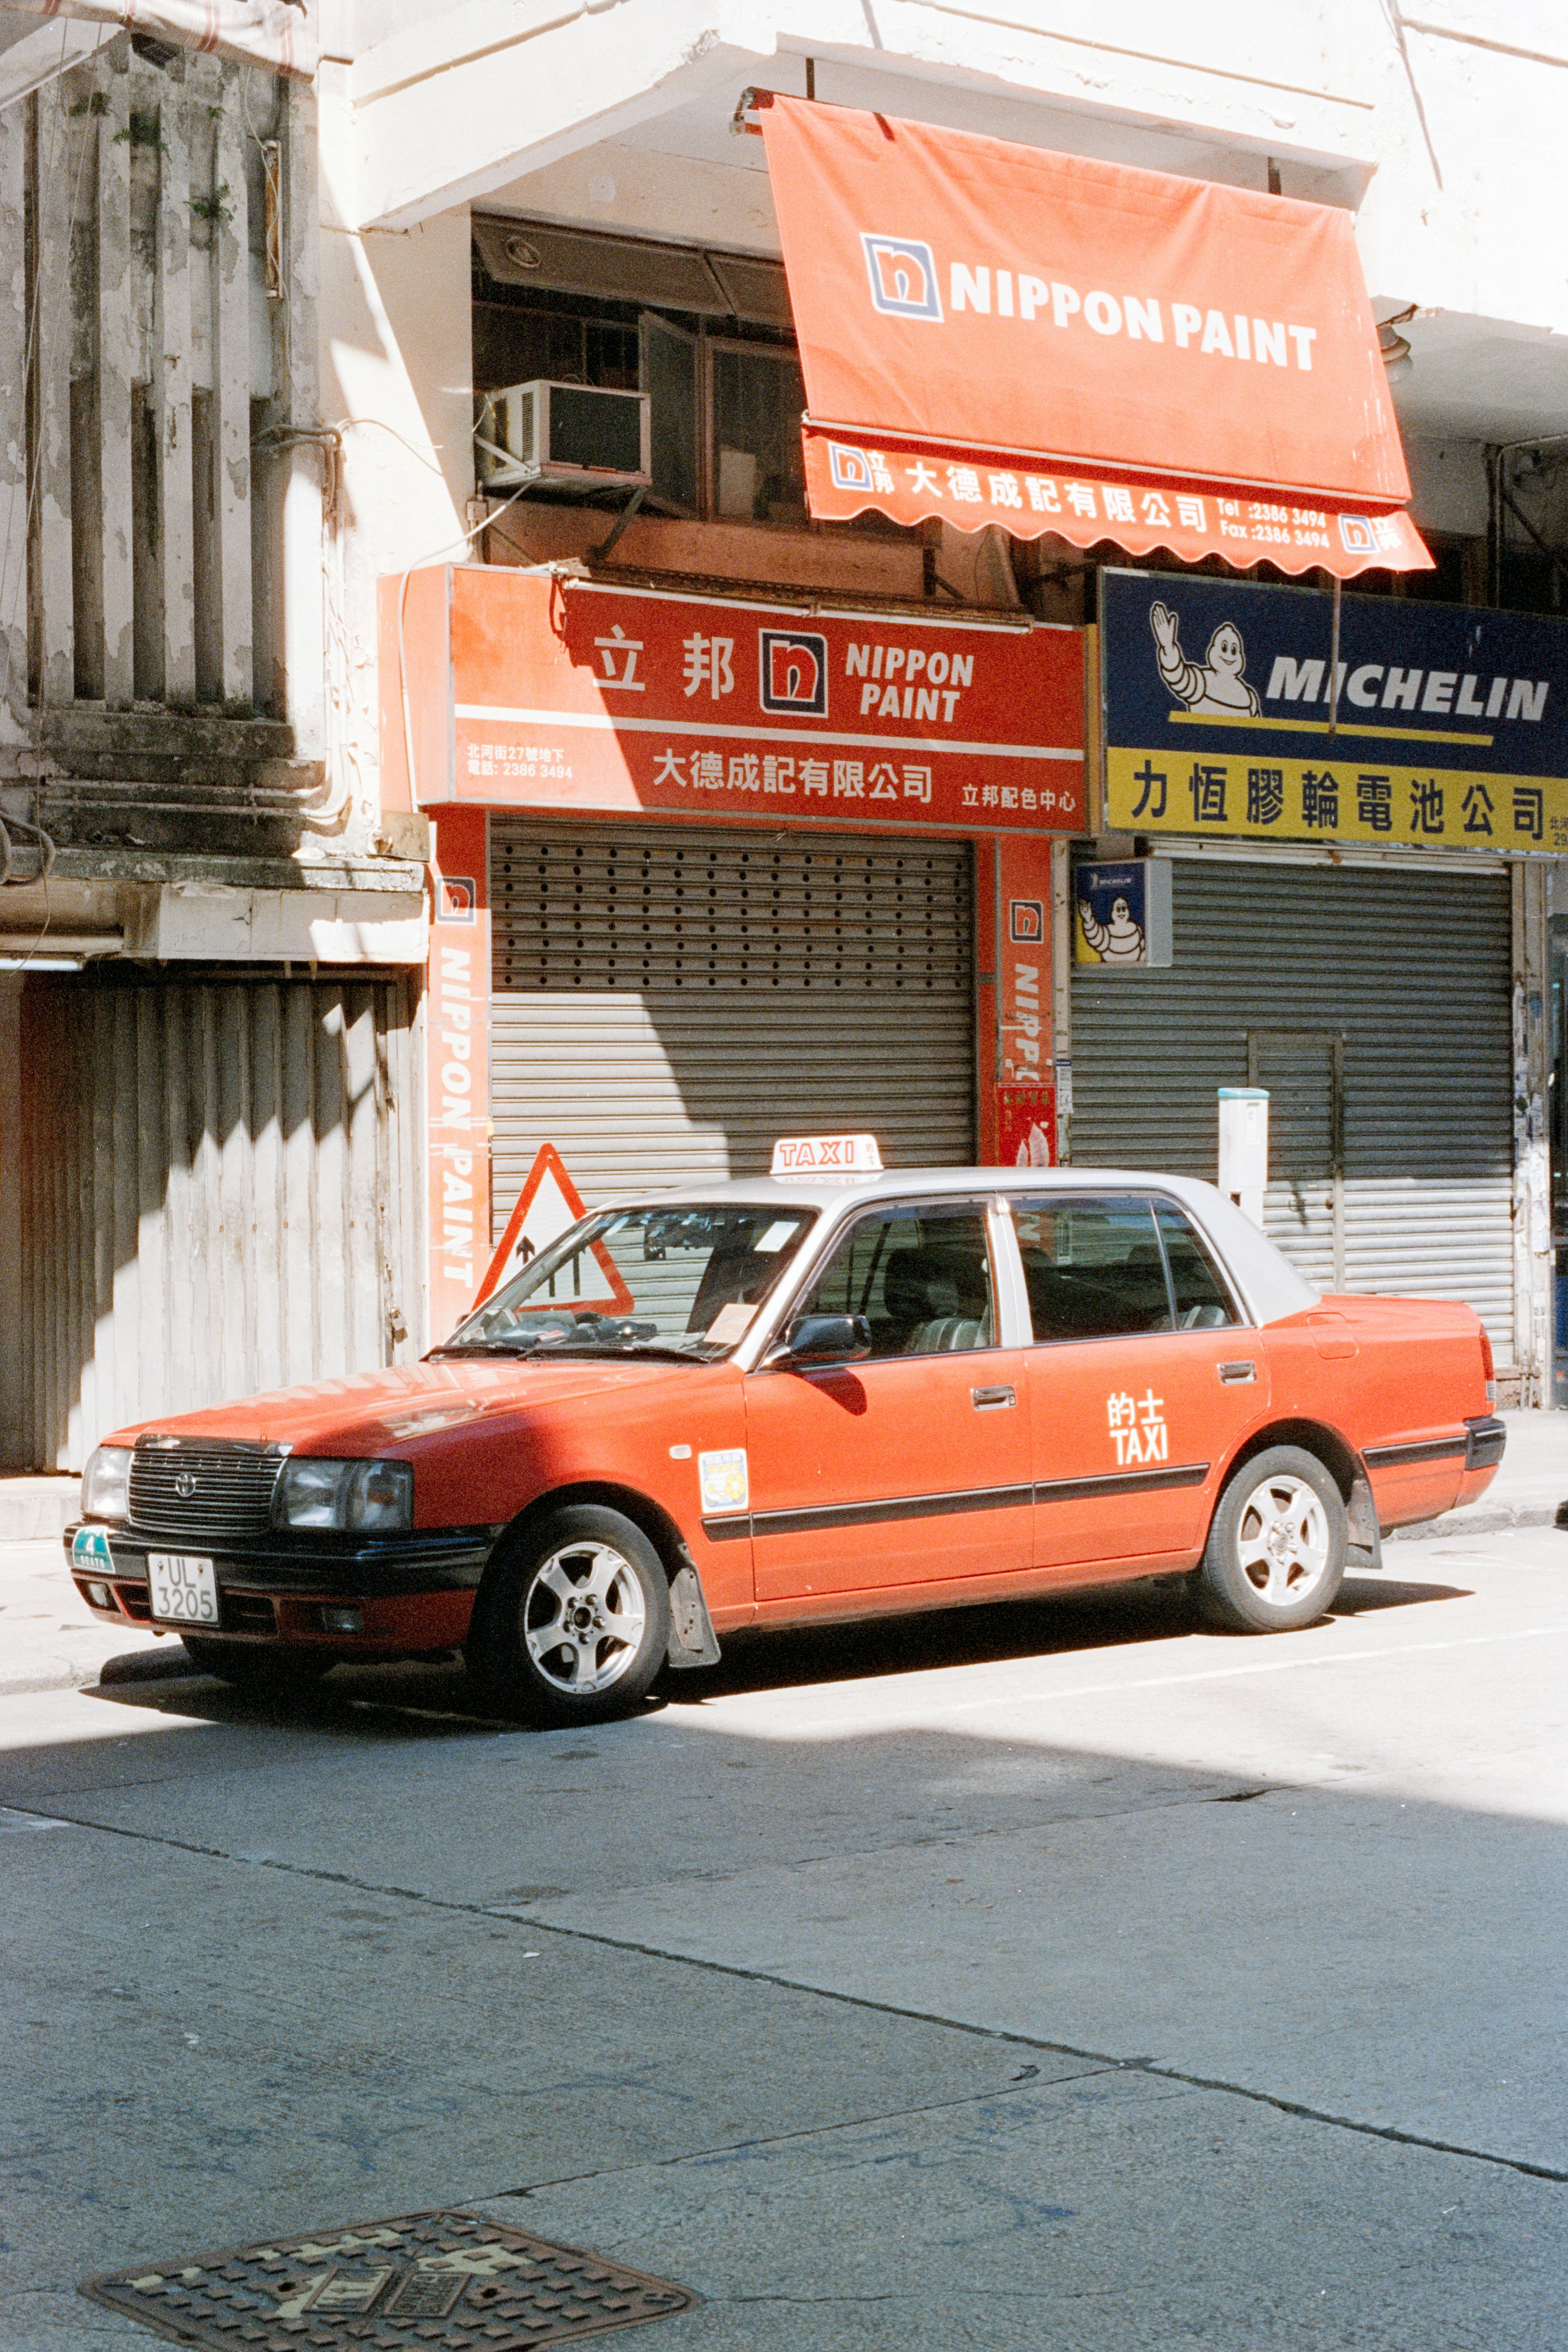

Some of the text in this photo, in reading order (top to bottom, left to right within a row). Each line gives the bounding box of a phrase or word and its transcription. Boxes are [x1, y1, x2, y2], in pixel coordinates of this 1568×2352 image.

[950, 261, 1164, 343] NIPPON
[1171, 302, 1317, 370] PAINT
[866, 451, 895, 494] 立邦
[905, 461, 1207, 533] 大德成記有限公司
[1216, 499, 1239, 517] Tel
[1292, 508, 1326, 528] 3494
[1220, 520, 1247, 539] Fax
[1294, 530, 1330, 549] 3494
[592, 624, 735, 700] 立邦
[845, 643, 974, 687] NIPPON
[860, 684, 961, 722] PAINT
[1265, 656, 1550, 721] MICHELIN
[468, 743, 565, 763] 北河街27號地下
[503, 762, 536, 777] 2386
[540, 764, 573, 779] 3494
[653, 748, 932, 803] 大德成記有限公司
[962, 783, 1076, 812] 立邦配色中心
[440, 946, 474, 1288] NIPPON PAINT
[779, 1140, 854, 1167] TAXI
[866, 1143, 875, 1166] 的士
[1107, 1389, 1163, 1427] 的士
[1110, 1424, 1168, 1465] TAXI
[80, 1555, 106, 1569] SEATS
[86, 1536, 95, 1555] 4
[167, 1557, 196, 1589] UL
[159, 1587, 213, 1620] 3205
